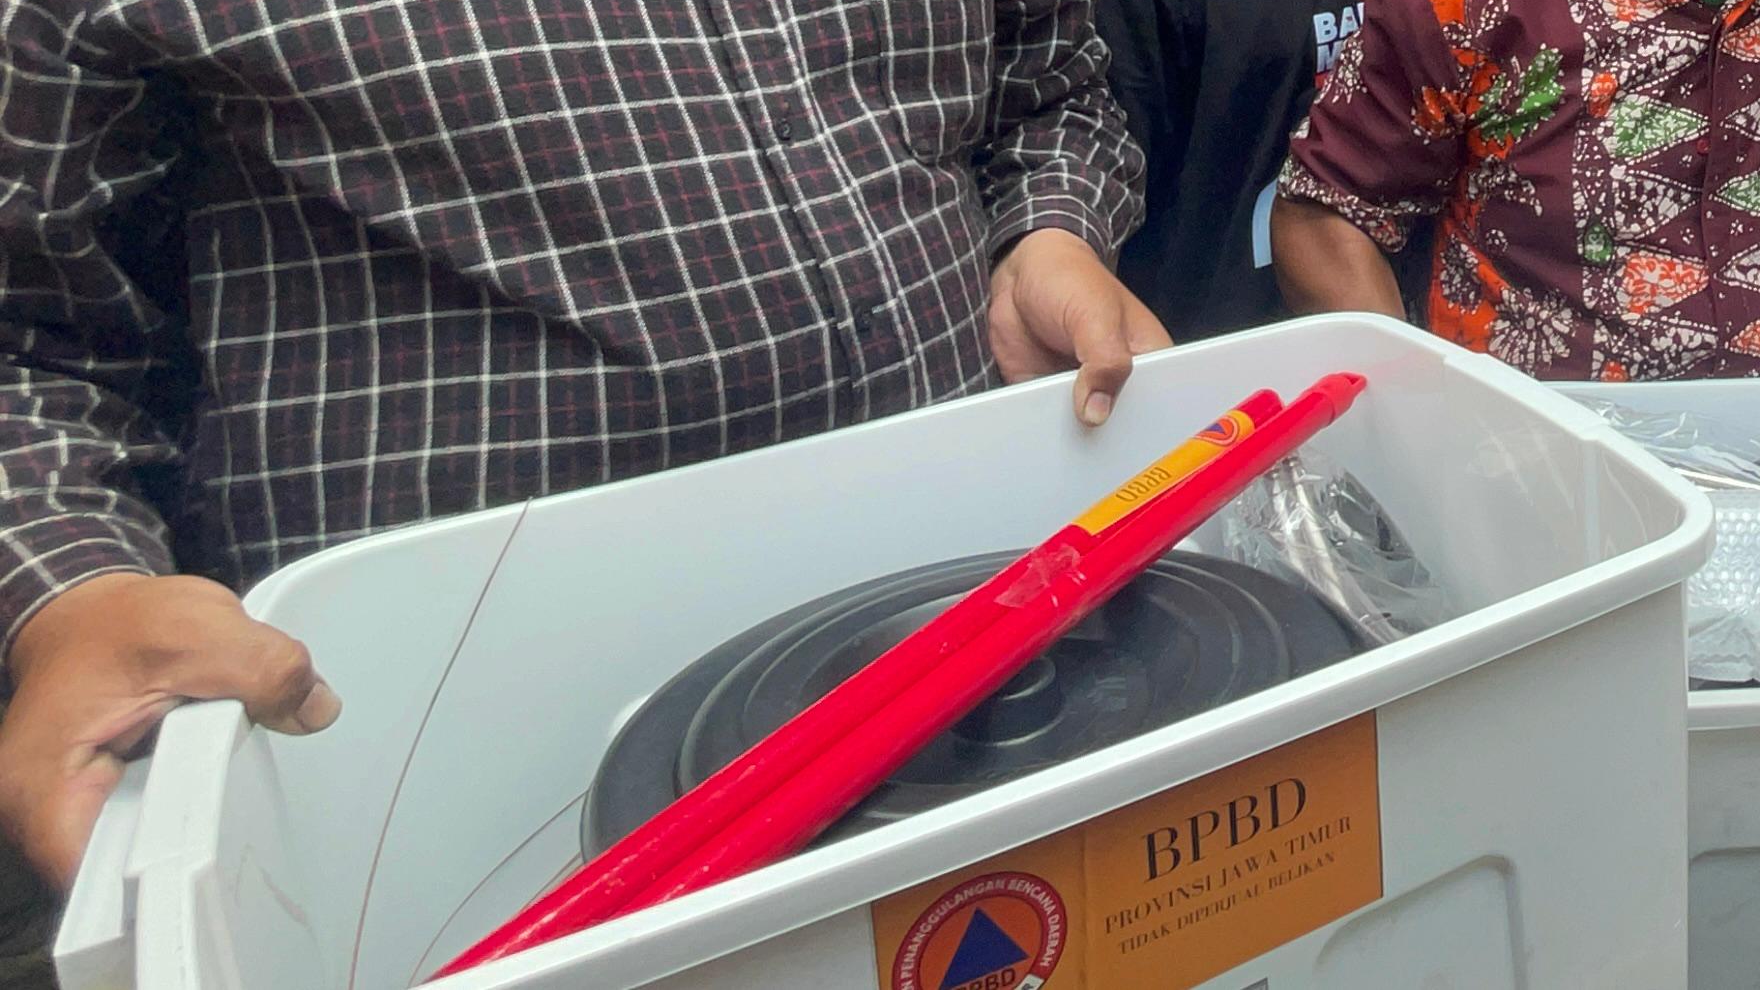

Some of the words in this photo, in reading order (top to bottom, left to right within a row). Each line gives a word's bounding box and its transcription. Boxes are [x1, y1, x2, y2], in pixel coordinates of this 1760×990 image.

[1115, 466, 1171, 502] BPBD
[1104, 875, 1212, 934] PROVINSI
[1218, 849, 1278, 889] JAWA
[1284, 816, 1351, 856] TIMUR
[1143, 777, 1307, 883] BPBD
[901, 878, 1005, 979] PENANGGULANGAN
[1008, 878, 1052, 915] BENCANA
[1040, 913, 1060, 967] DAERAH
[1118, 923, 1170, 955] TIDAK
[1268, 850, 1335, 890] BELIKAN
[955, 968, 1016, 990] PBD
